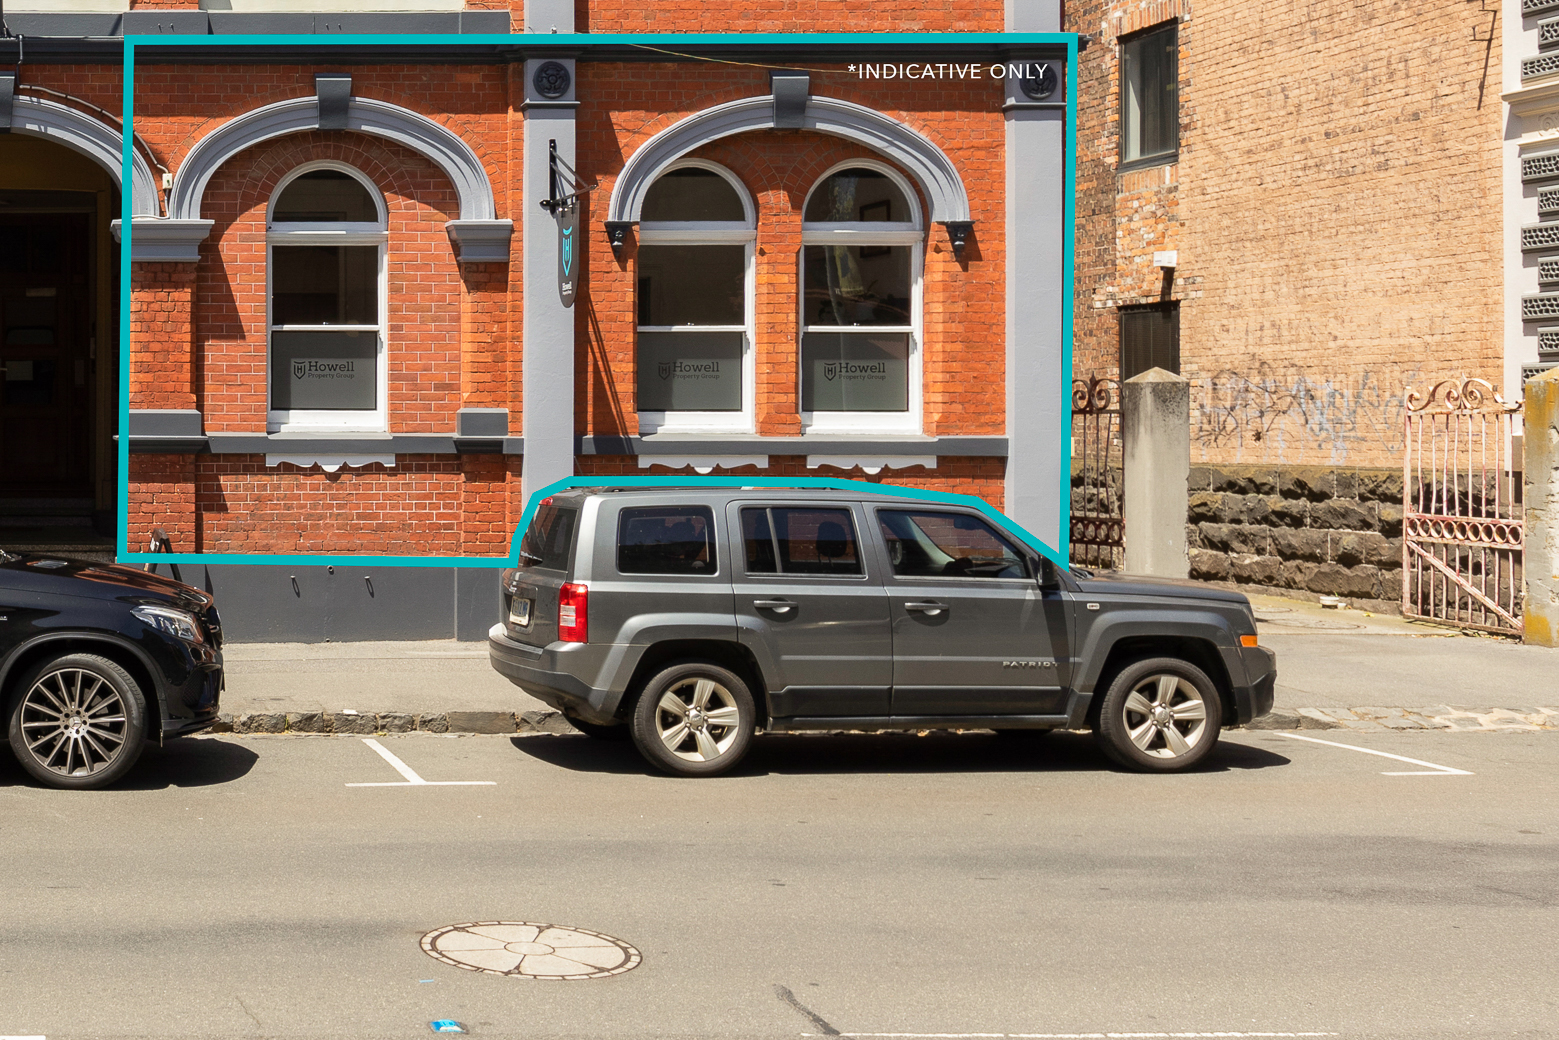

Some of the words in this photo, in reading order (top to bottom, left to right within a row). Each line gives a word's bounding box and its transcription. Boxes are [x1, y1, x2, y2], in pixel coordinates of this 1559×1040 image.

[308, 361, 354, 371] Howell
[672, 362, 719, 372] Howell
[839, 362, 885, 373] Howell
